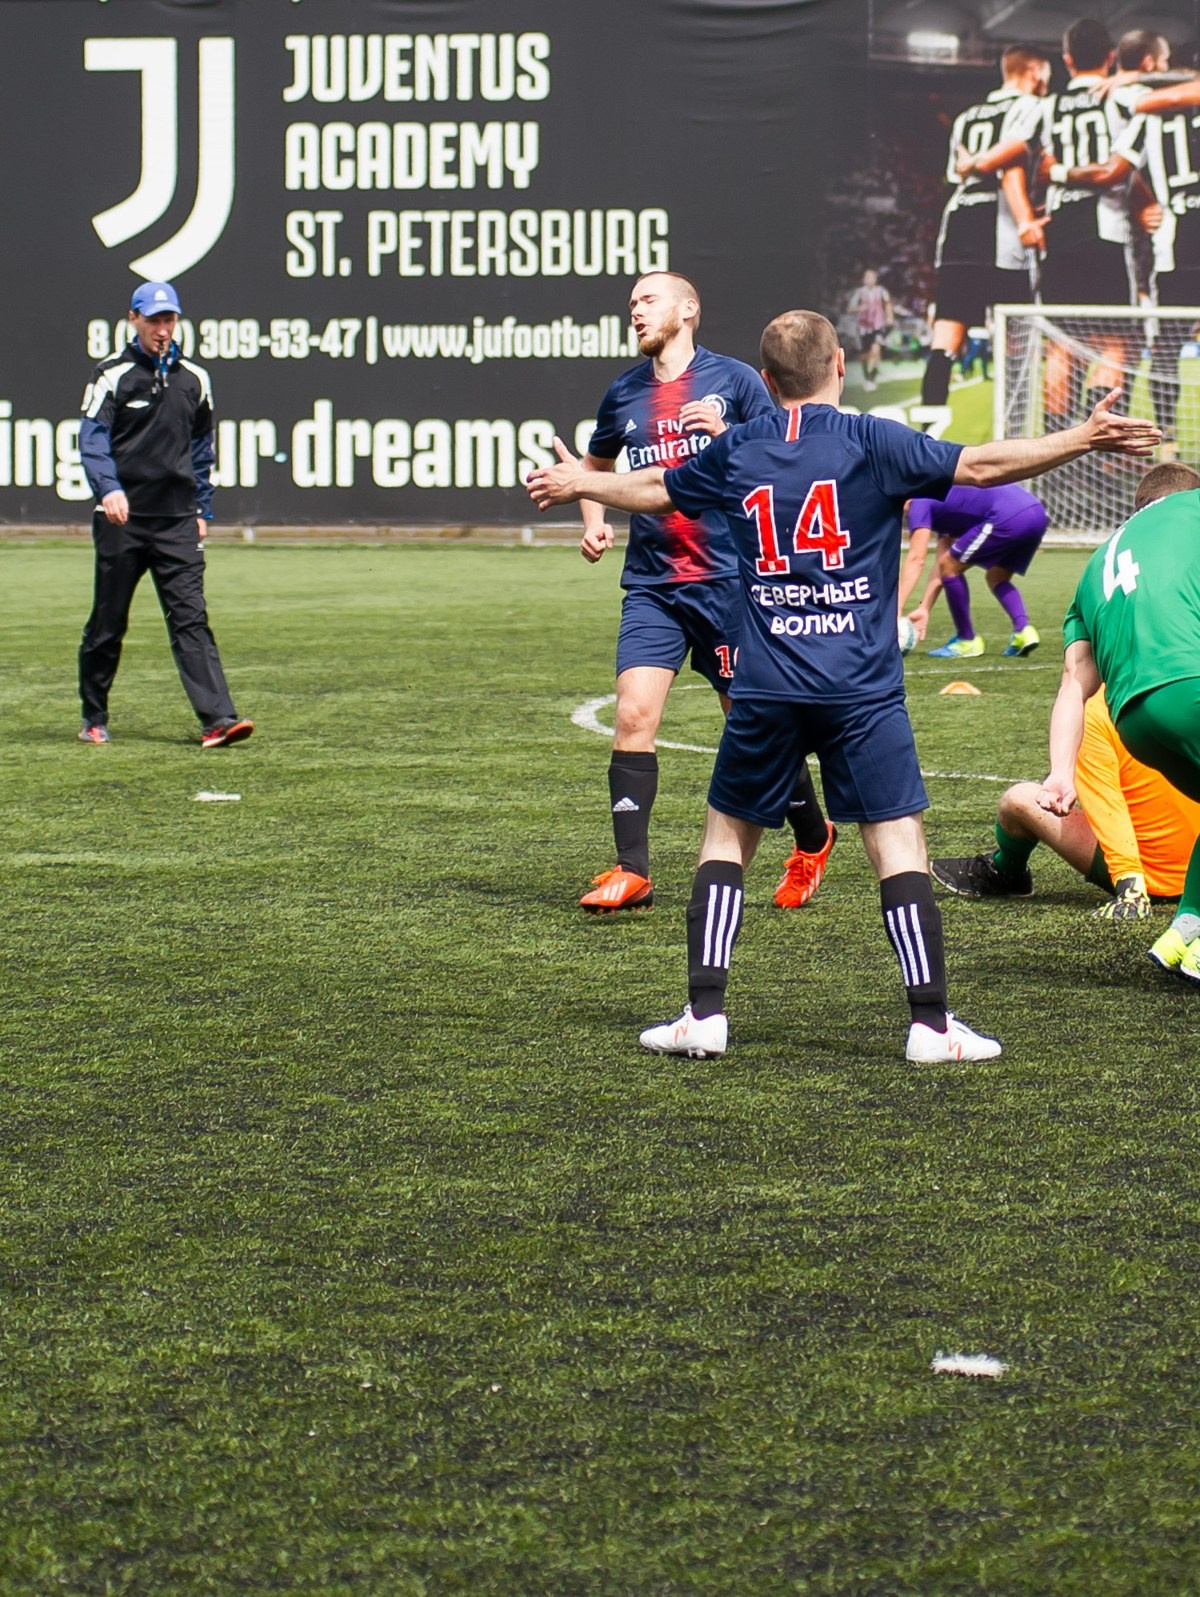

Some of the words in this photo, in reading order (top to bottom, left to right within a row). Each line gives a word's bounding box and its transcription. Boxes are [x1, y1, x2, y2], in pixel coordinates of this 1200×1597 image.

[284, 33, 550, 102] JUVENTUS
[285, 122, 539, 190] ACADEMY
[286, 210, 352, 277] ST.
[368, 209, 669, 277] PETERSBURG
[87, 319, 110, 359] 8
[199, 318, 362, 359] 309-53-47
[382, 315, 639, 364] www.jufootball.r
[208, 418, 277, 488] ur
[291, 399, 557, 489] dreams
[630, 434, 712, 469] Emirate
[657, 420, 683, 436] Fly
[742, 479, 850, 576] 14
[751, 576, 871, 607] СЕВЕРНЫЕ
[1103, 527, 1140, 602] 4
[770, 611, 855, 636] ВОЛКИ
[714, 645, 739, 678] 1
